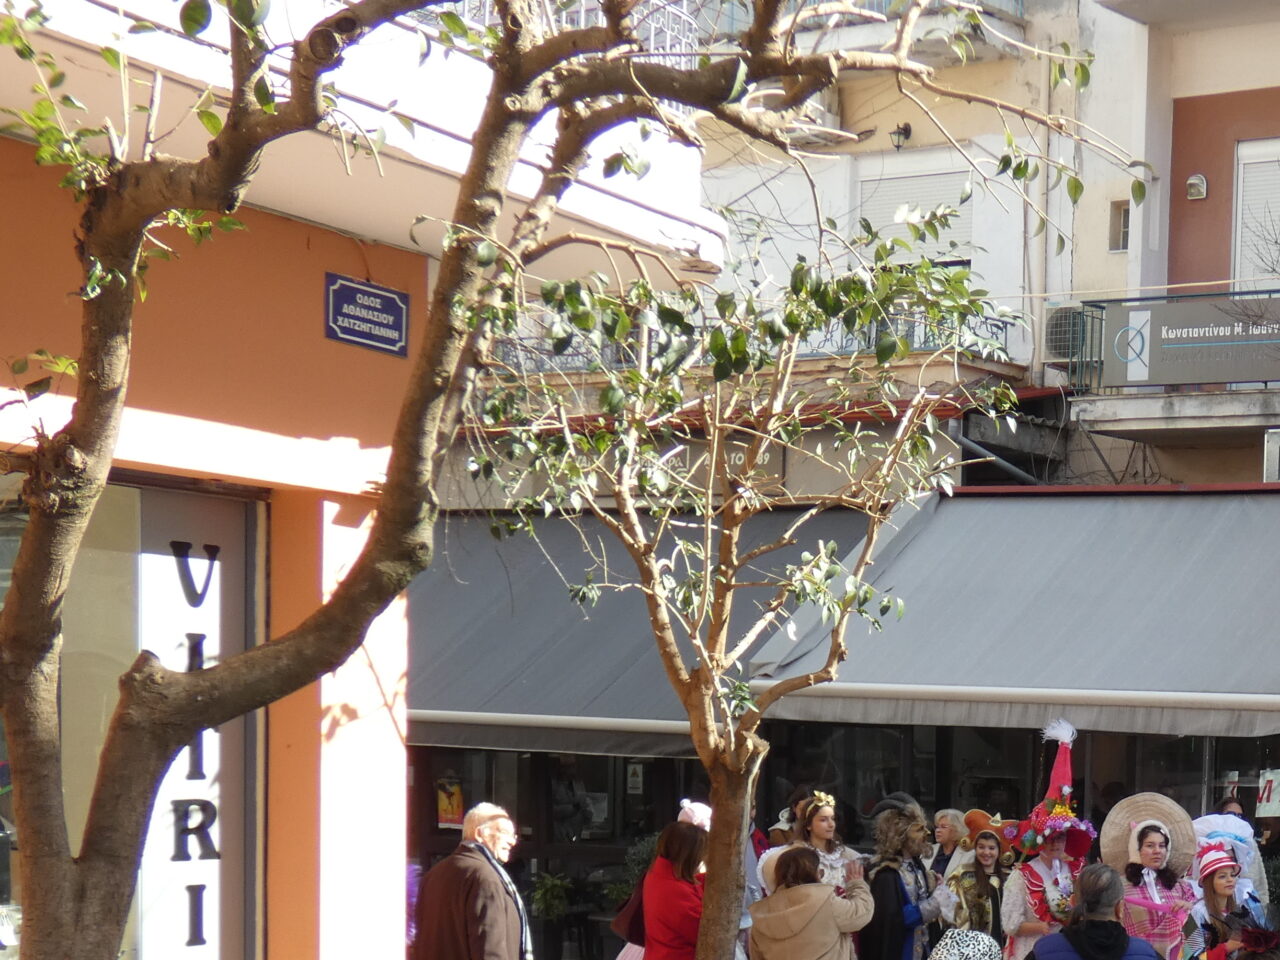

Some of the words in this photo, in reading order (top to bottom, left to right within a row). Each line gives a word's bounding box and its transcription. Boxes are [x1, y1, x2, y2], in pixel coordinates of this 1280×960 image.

[356, 294, 381, 308] ΟΔΟΣ
[342, 304, 394, 324] ΑΘΑΝΑΣΙΟΥ
[337, 316, 399, 339] ΧΑΤΖΗΓΙΑΝΝΗ
[1161, 323, 1231, 339] Κωνσταντίνου
